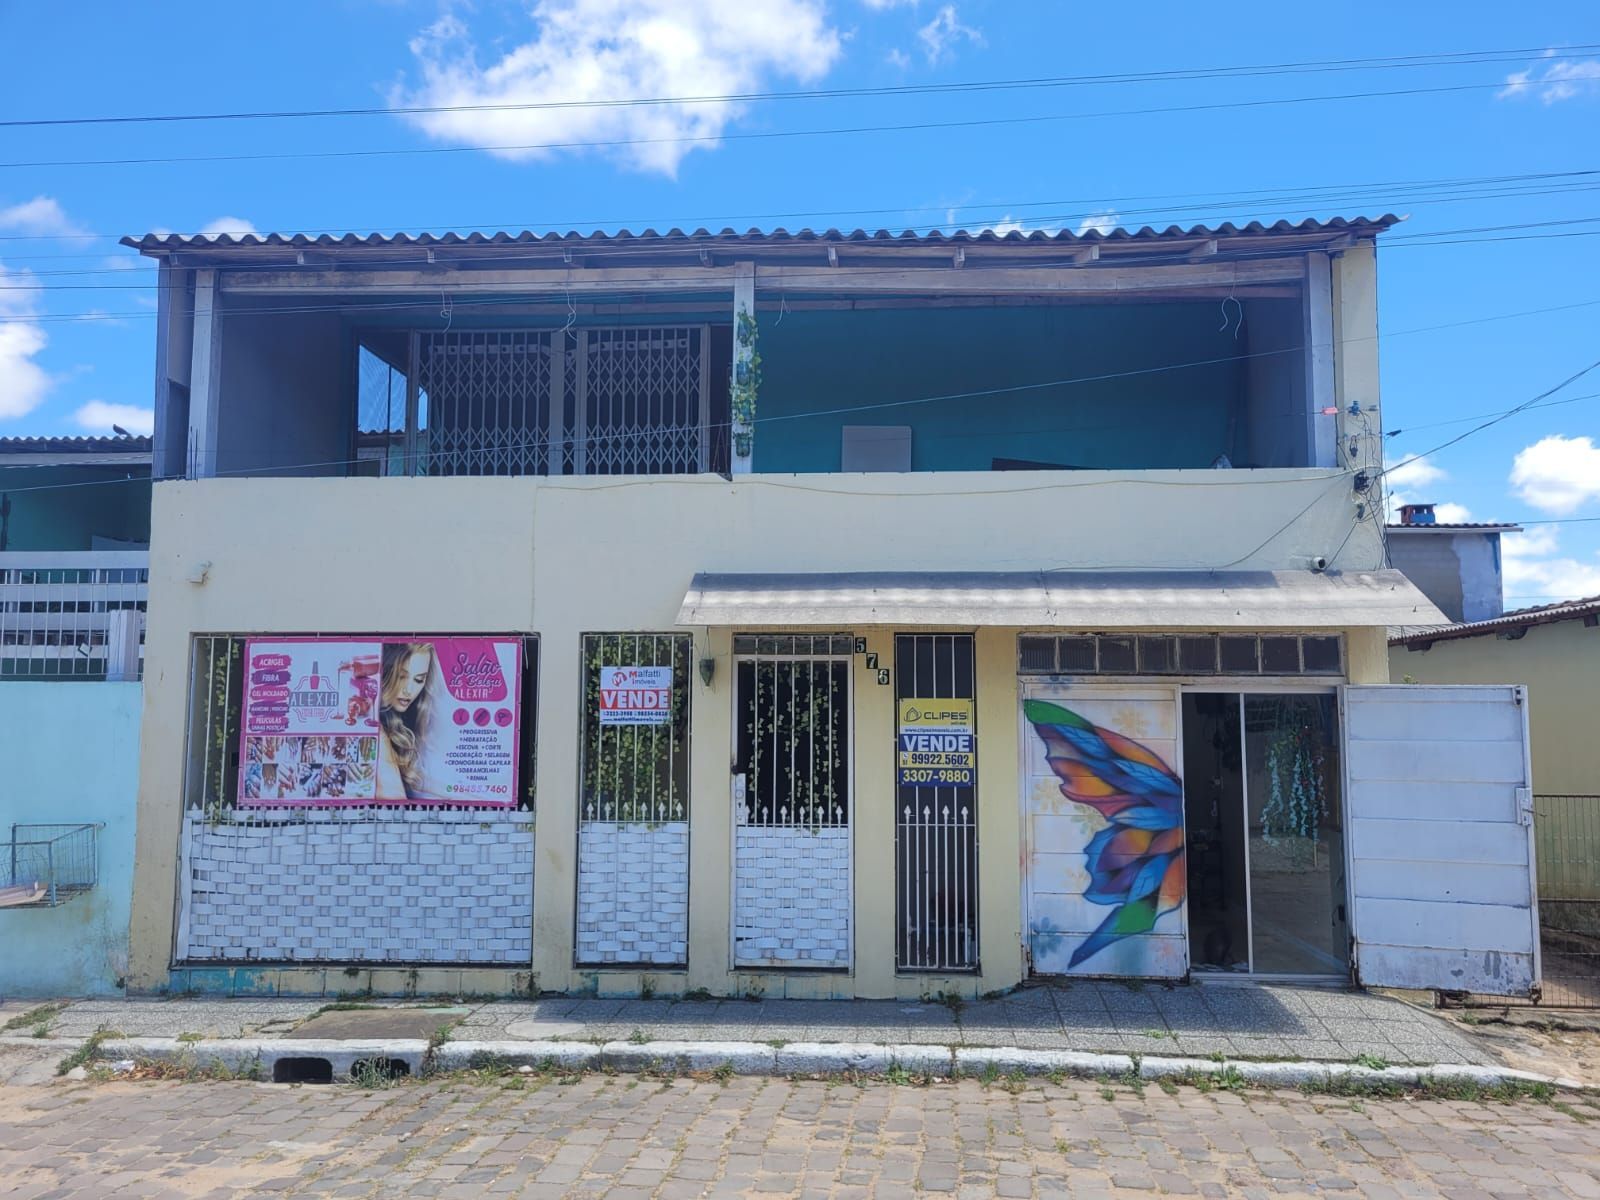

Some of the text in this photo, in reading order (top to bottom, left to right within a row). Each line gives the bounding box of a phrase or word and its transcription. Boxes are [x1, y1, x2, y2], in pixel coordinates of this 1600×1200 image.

[259, 658, 285, 666] ACRIGEL
[451, 653, 502, 676] Salão
[262, 673, 280, 682] FIBRA
[629, 670, 661, 678] Malfatti
[449, 673, 503, 693] de Beleza
[290, 692, 338, 706] ALEXIA
[455, 688, 489, 699] ALEXIA
[601, 690, 669, 708] VENDE
[923, 711, 968, 721] CLIPES
[903, 735, 970, 752] VENDE
[448, 751, 483, 759] COLORAÇÃO
[911, 753, 969, 766] 99922.5602
[902, 769, 970, 783] 3307-9880
